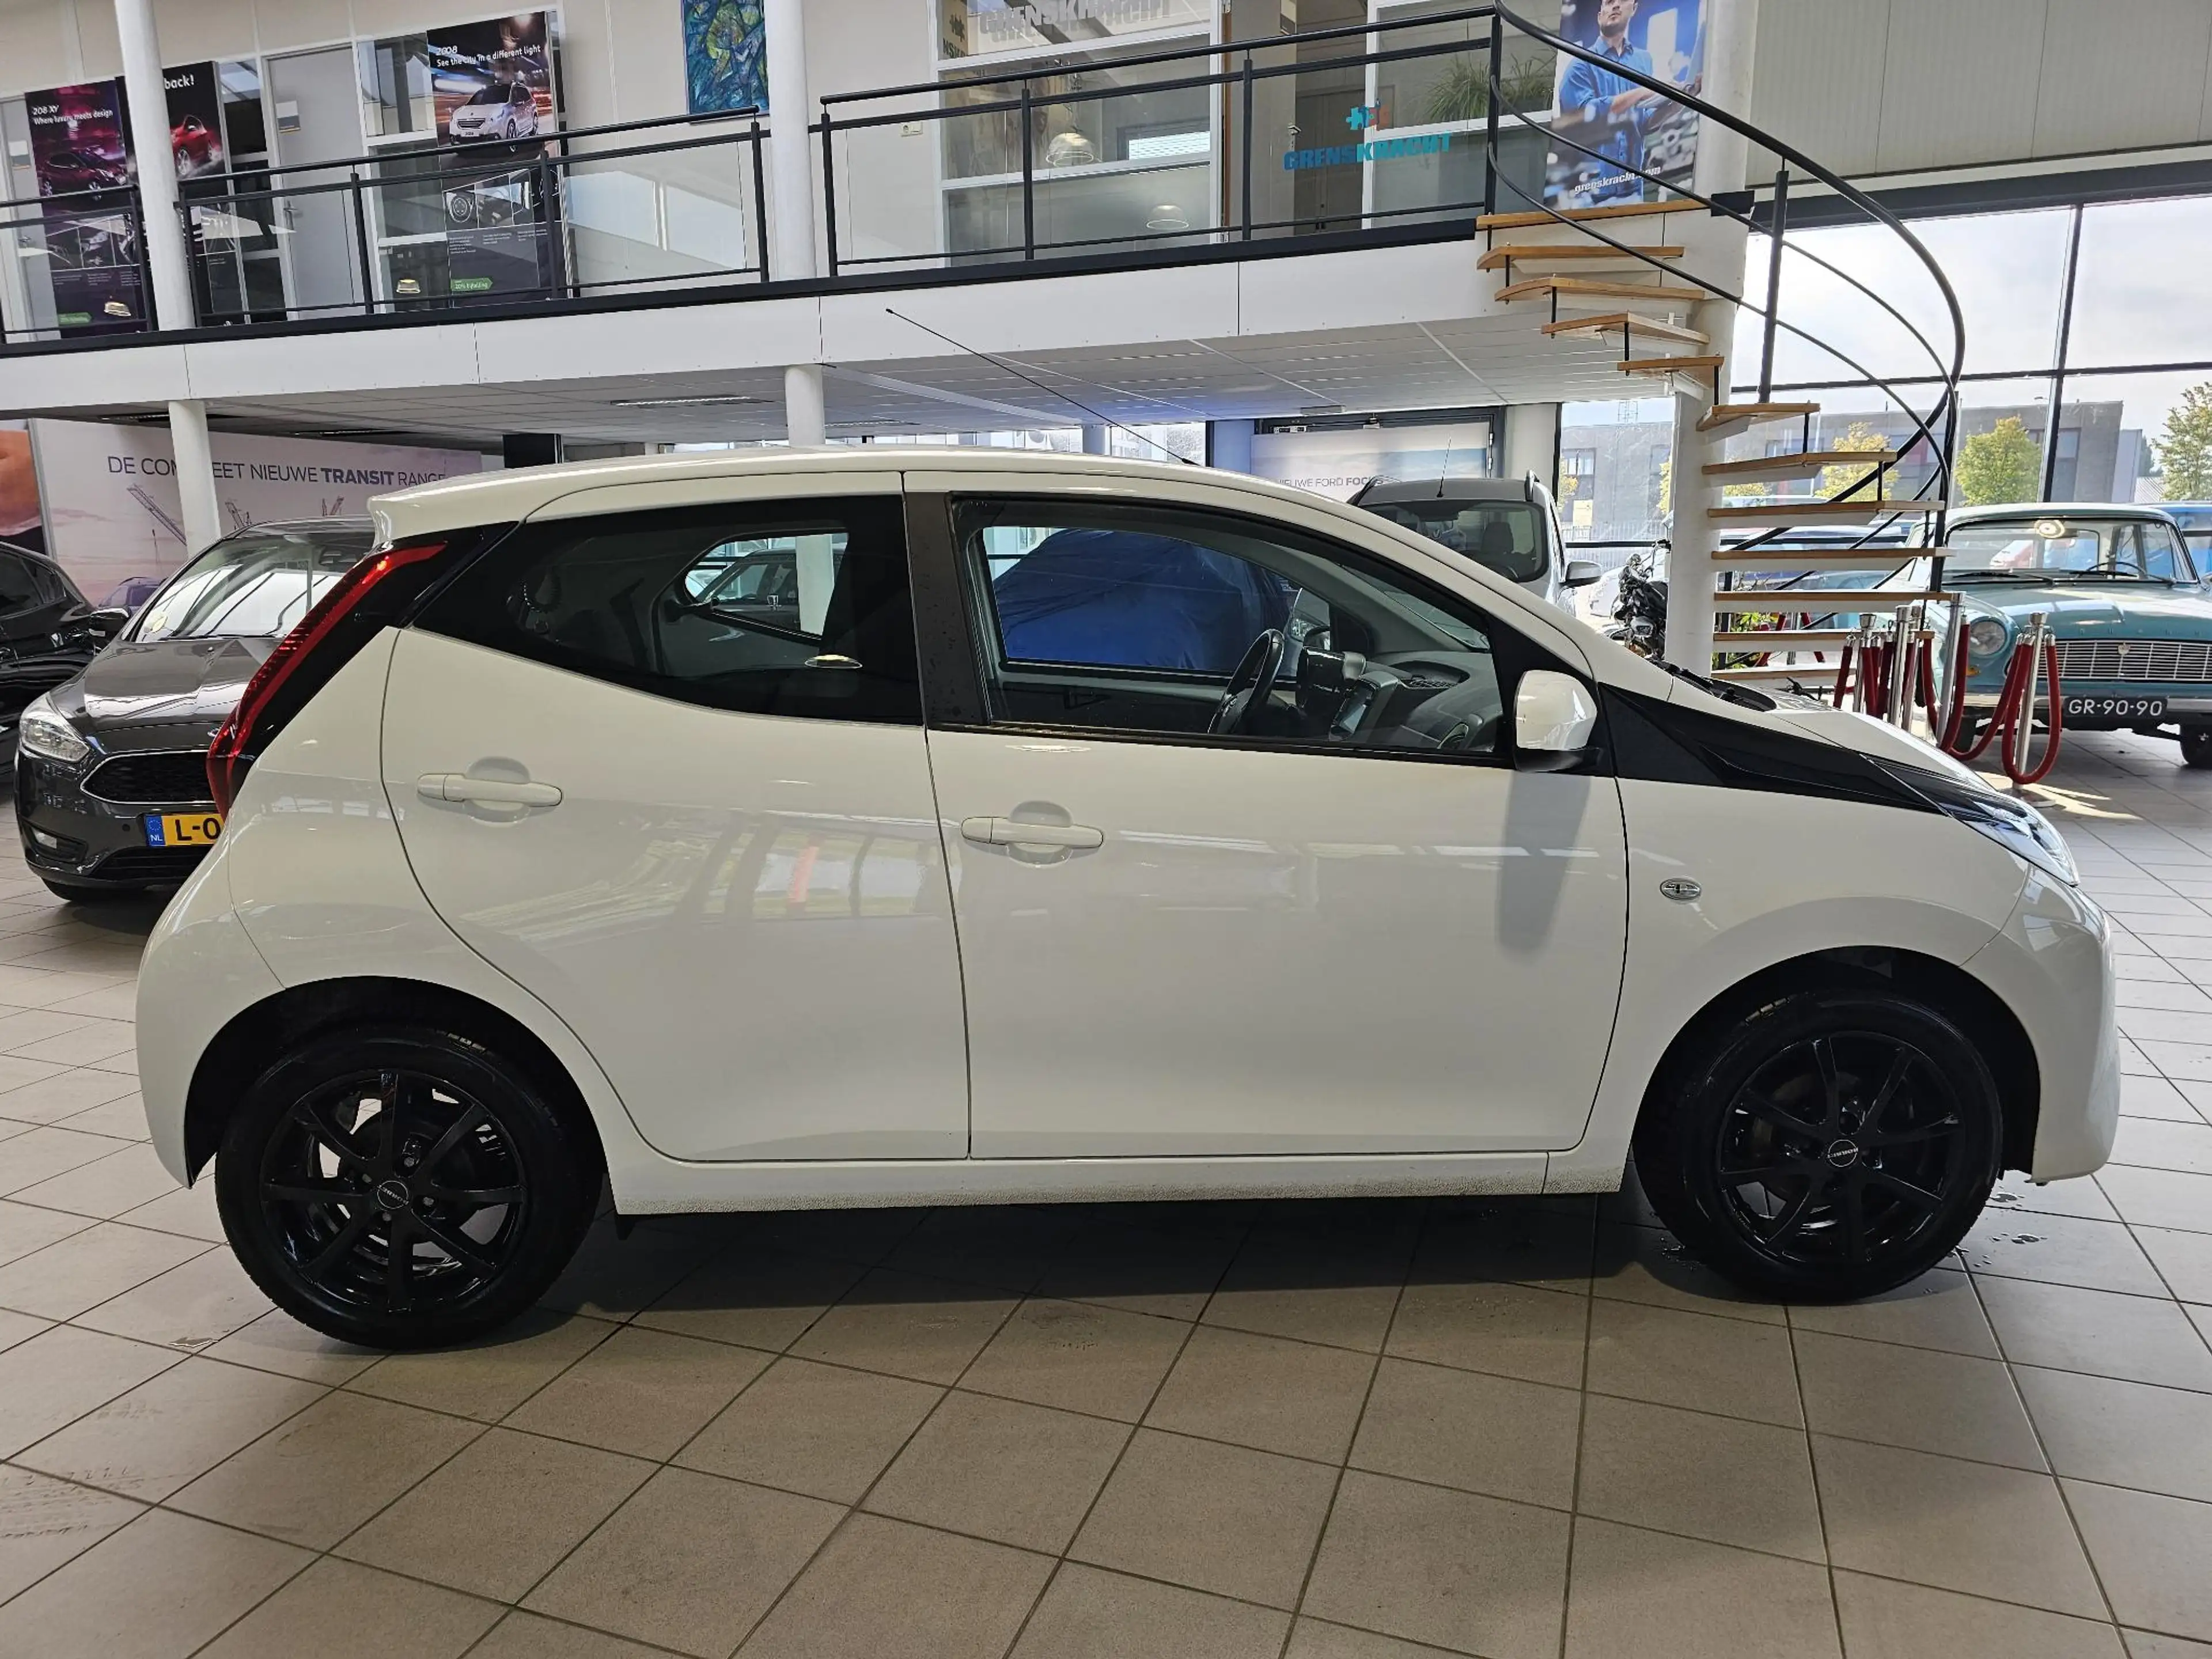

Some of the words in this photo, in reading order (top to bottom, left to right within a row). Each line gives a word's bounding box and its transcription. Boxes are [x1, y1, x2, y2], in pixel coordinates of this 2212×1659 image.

[437, 46, 458, 56] 2008
[437, 59, 449, 67] See
[450, 57, 462, 66] the
[476, 54, 485, 62] in
[493, 48, 522, 60] different
[524, 44, 541, 56] light
[164, 74, 194, 89] back!
[33, 107, 48, 115] 208
[49, 105, 59, 113] XY
[33, 117, 54, 125] Where
[74, 112, 92, 120] meets
[93, 109, 113, 119] design
[1283, 132, 1451, 171] GRENSKRACHT
[108, 456, 136, 474] DE
[250, 463, 319, 482] NIEUWE
[320, 467, 394, 486] TRANSIT
[1279, 479, 1313, 487] IEUWE
[1315, 477, 1344, 487] FORD
[2069, 699, 2163, 716] GR-90-90
